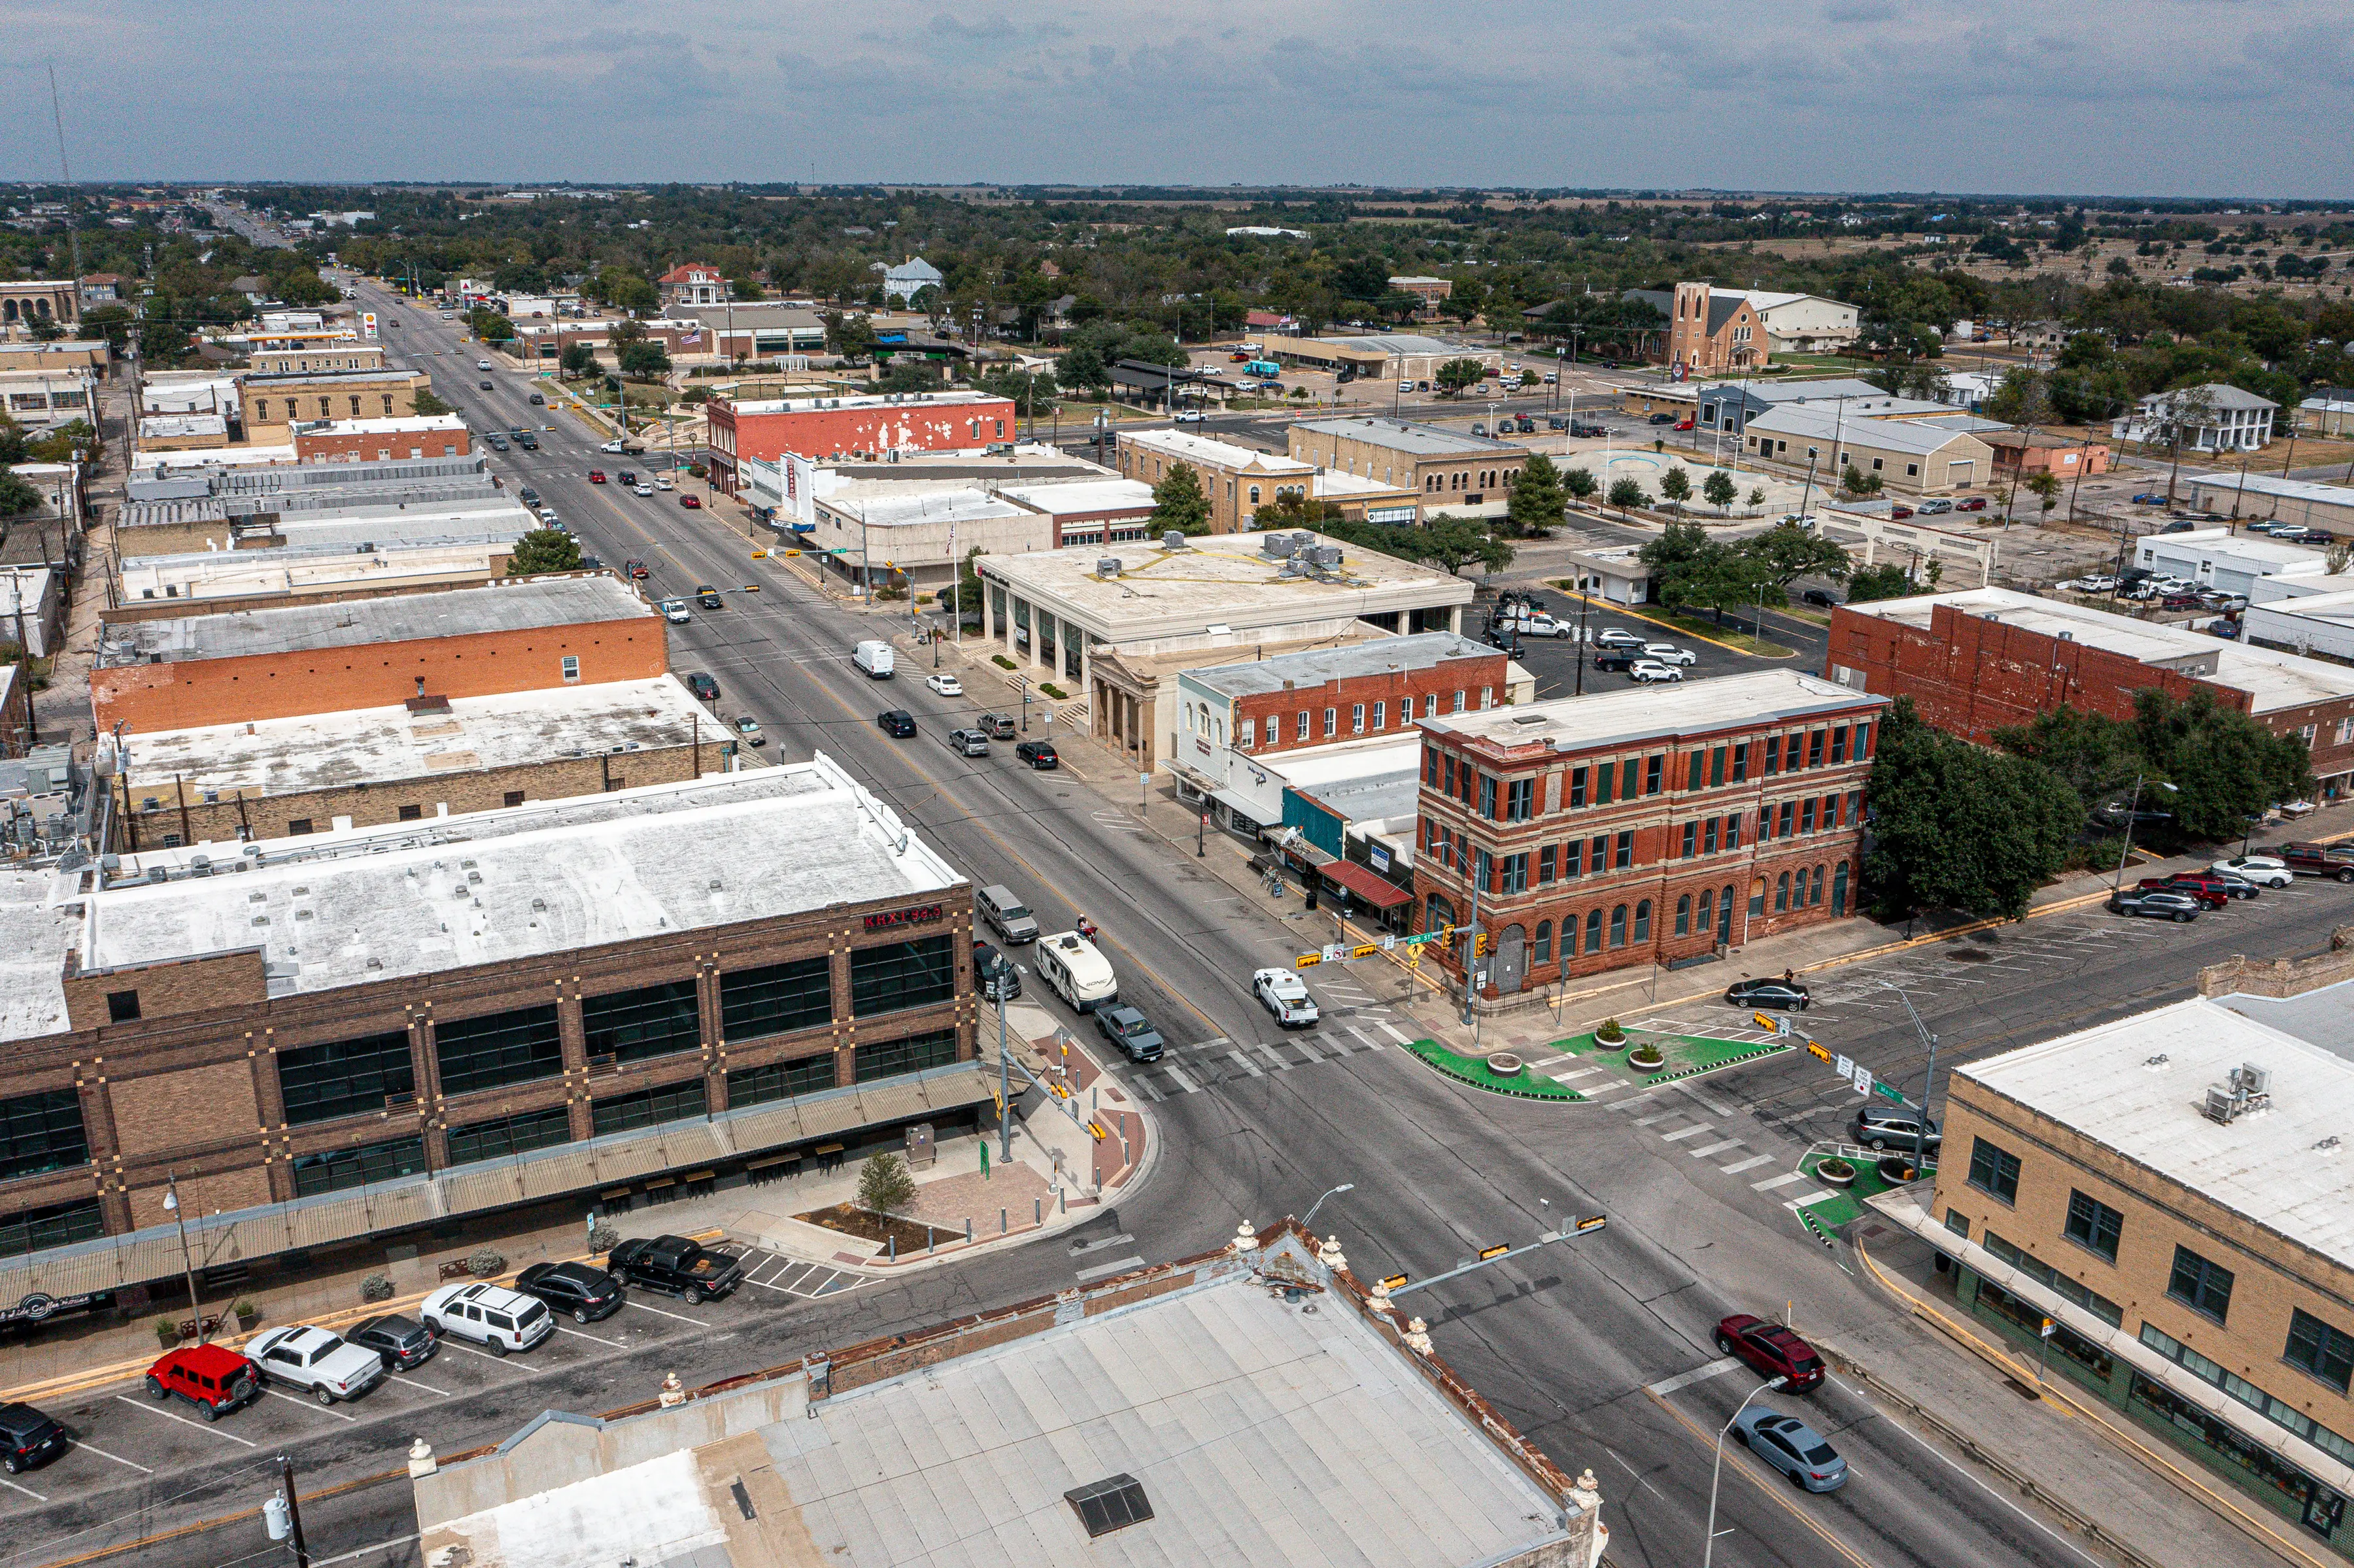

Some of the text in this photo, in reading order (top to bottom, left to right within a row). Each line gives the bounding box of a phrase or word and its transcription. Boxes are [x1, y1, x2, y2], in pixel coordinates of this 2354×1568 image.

[1196, 738, 1211, 751] WESTERN
[1197, 745, 1210, 757] FINANCE
[1085, 978, 1108, 987] SONIC
[1880, 1085, 1894, 1098] Main
[33, 1301, 60, 1314] Coffee
